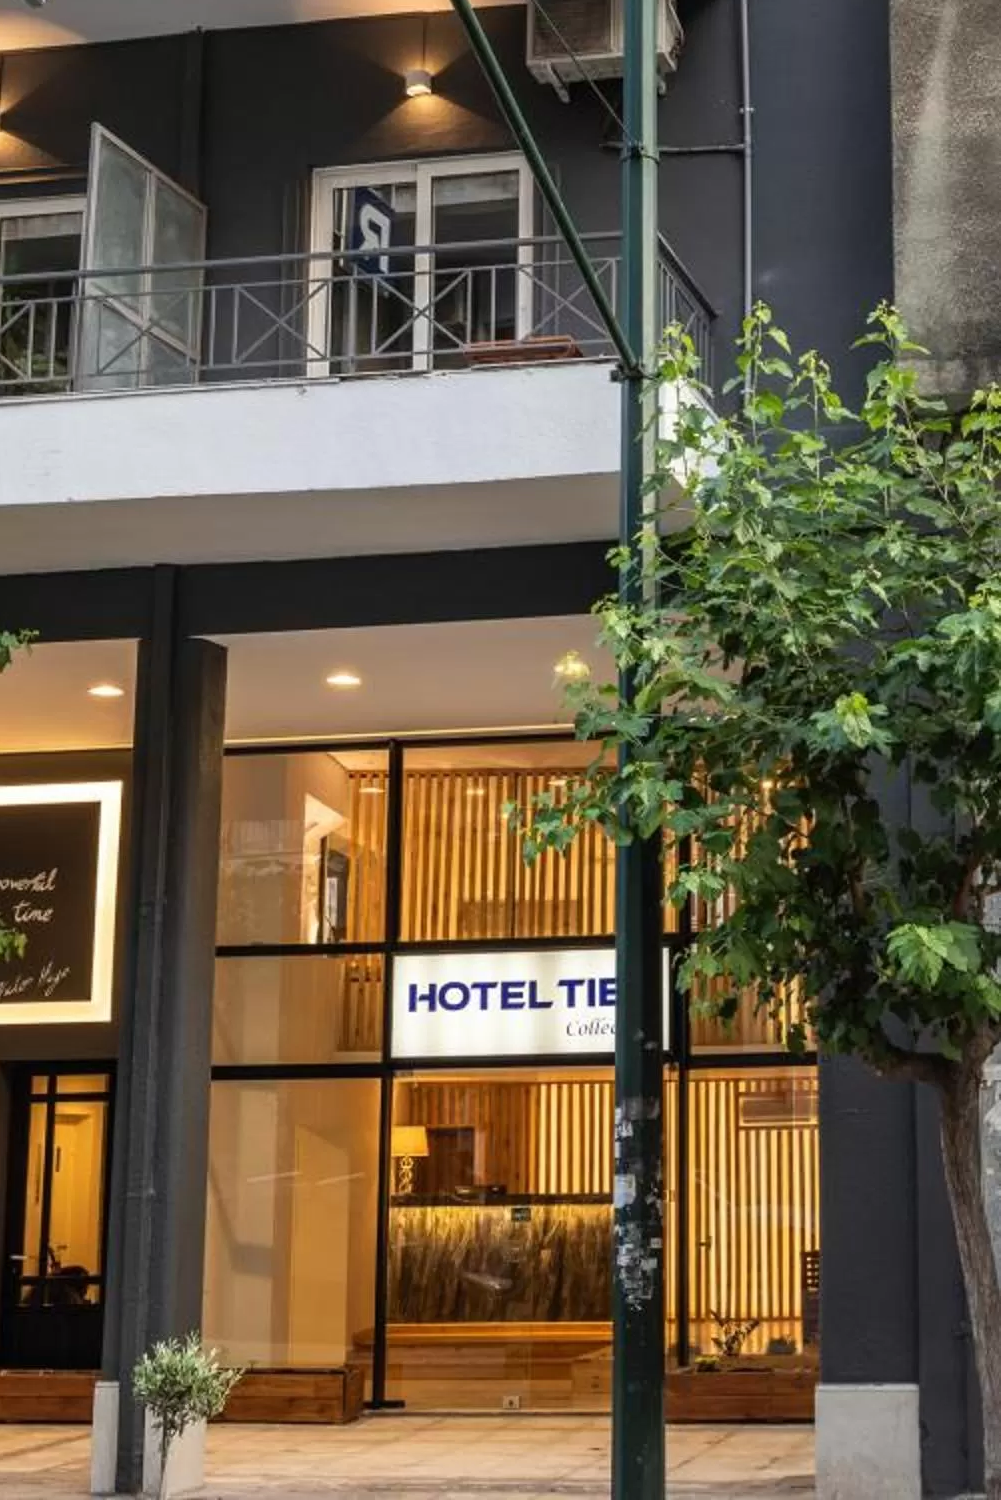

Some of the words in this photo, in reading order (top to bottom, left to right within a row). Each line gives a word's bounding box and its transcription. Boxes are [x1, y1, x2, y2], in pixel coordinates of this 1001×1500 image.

[13, 900, 55, 923] time
[408, 980, 554, 1012] HOTEL
[557, 977, 616, 1008] TIE
[566, 1016, 616, 1037] Collec
